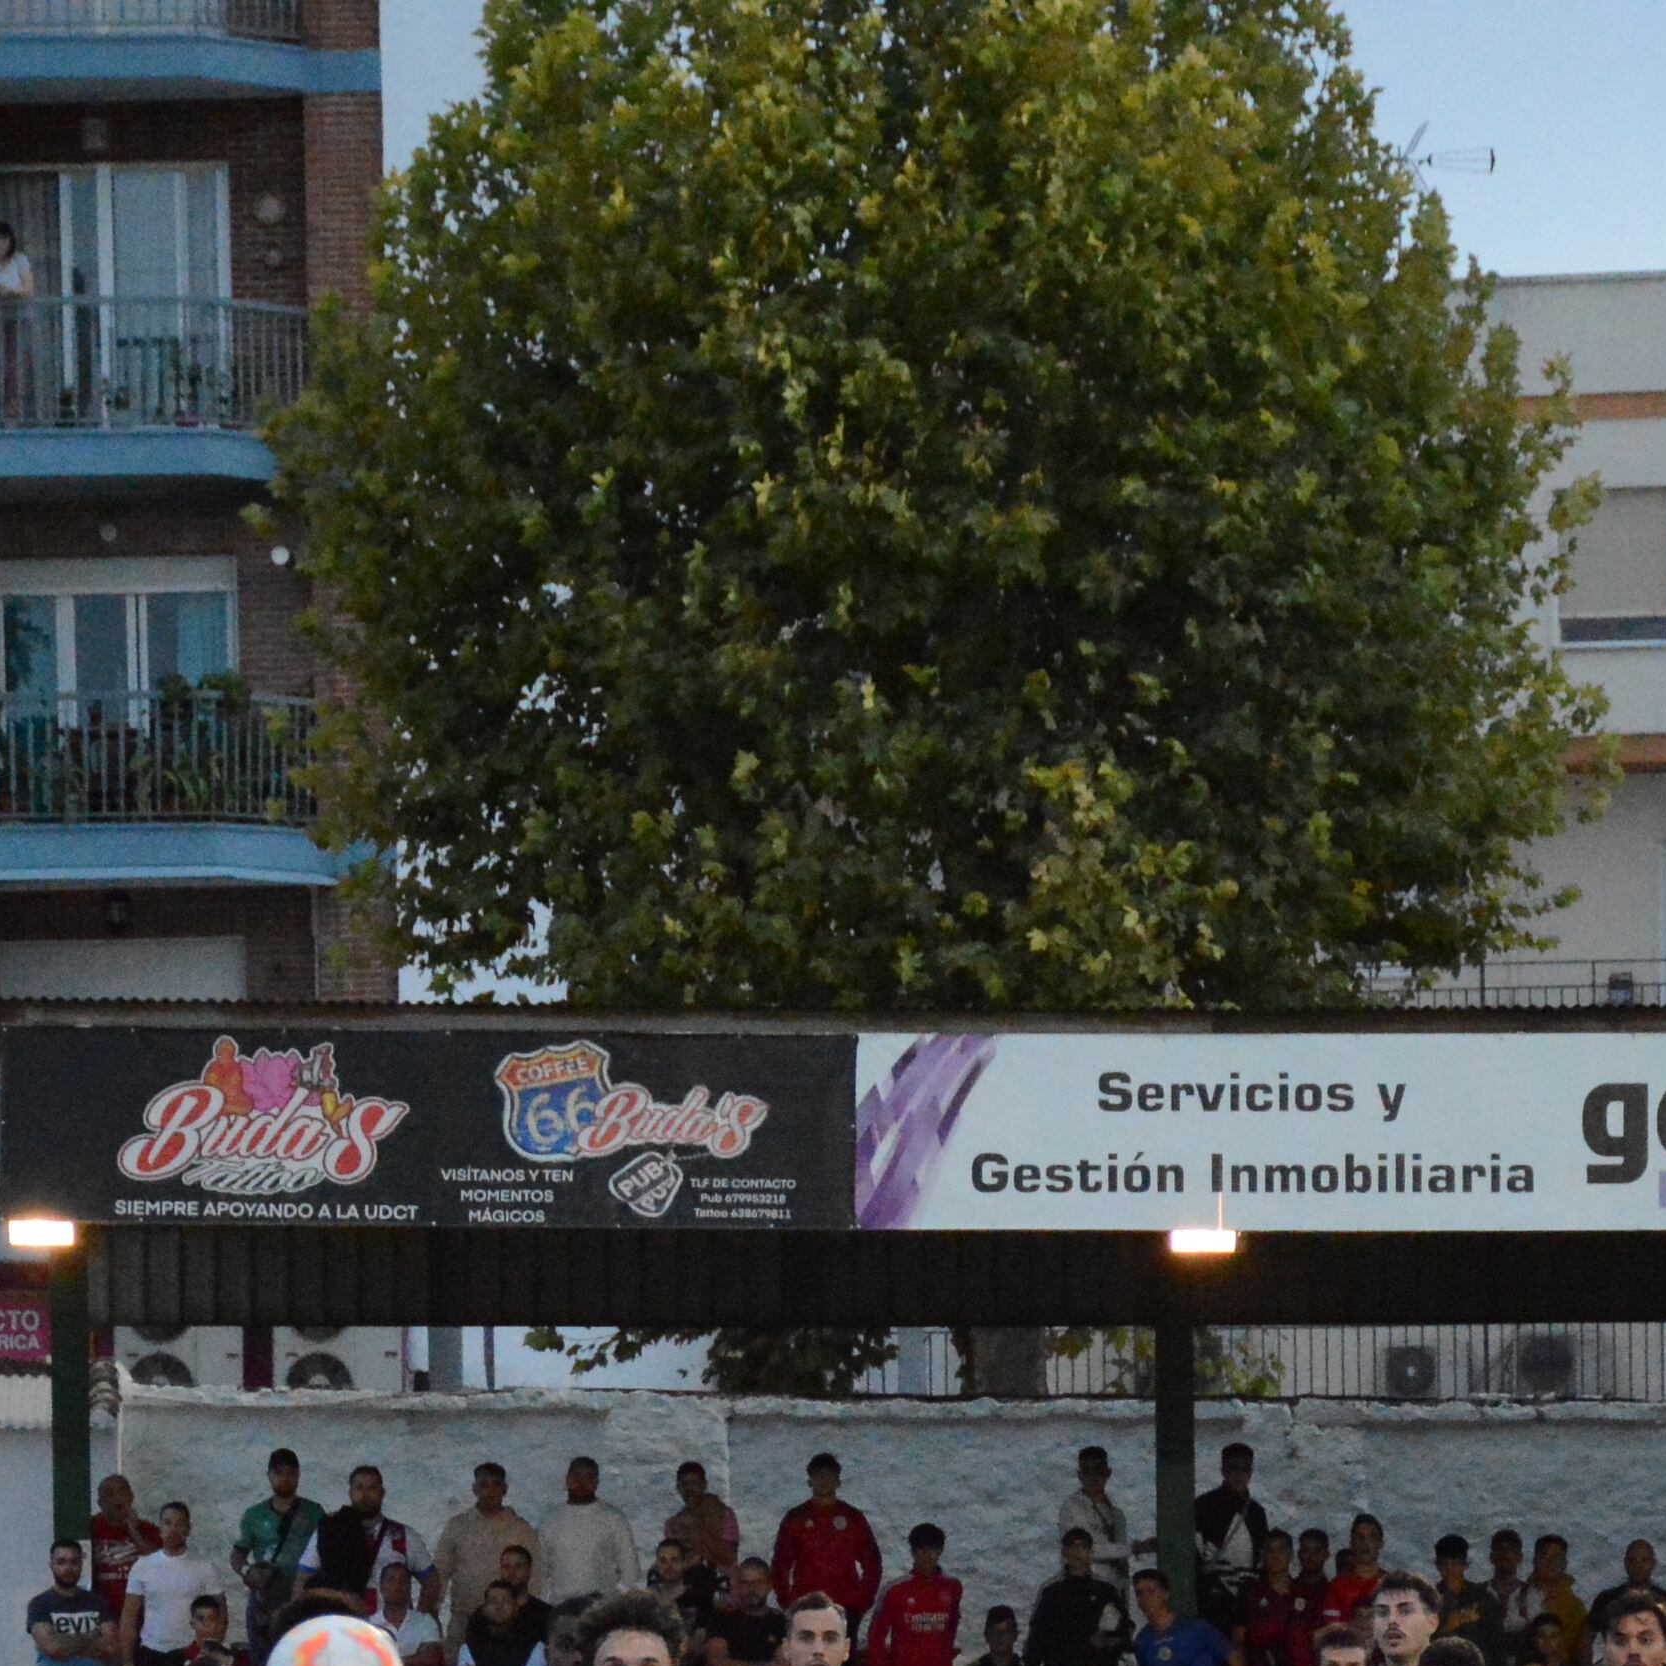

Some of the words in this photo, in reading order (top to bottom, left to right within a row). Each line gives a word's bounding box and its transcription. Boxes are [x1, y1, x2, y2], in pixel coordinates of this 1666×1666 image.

[516, 1058, 590, 1082] COFFEE
[1096, 1070, 1355, 1114] Servicios
[1377, 1082, 1406, 1121] y
[441, 1166, 525, 1183] VISÍTANOS
[528, 1169, 540, 1182] Y
[543, 1169, 574, 1183] TEN
[618, 1161, 665, 1197] PUB
[971, 1152, 1184, 1194] Gestión
[1211, 1152, 1535, 1194] Inmobiliaria
[689, 1178, 709, 1189] TLF
[713, 1178, 729, 1189] DE
[731, 1178, 797, 1190] CONTACTO
[460, 1189, 554, 1204] MOMENTOS
[114, 1200, 199, 1216] SIEMPRE
[203, 1202, 313, 1218] APOYANDO
[318, 1203, 332, 1218] A
[337, 1203, 359, 1219] LA
[364, 1204, 419, 1220] UDCT
[468, 1207, 546, 1223] MÁGICOS
